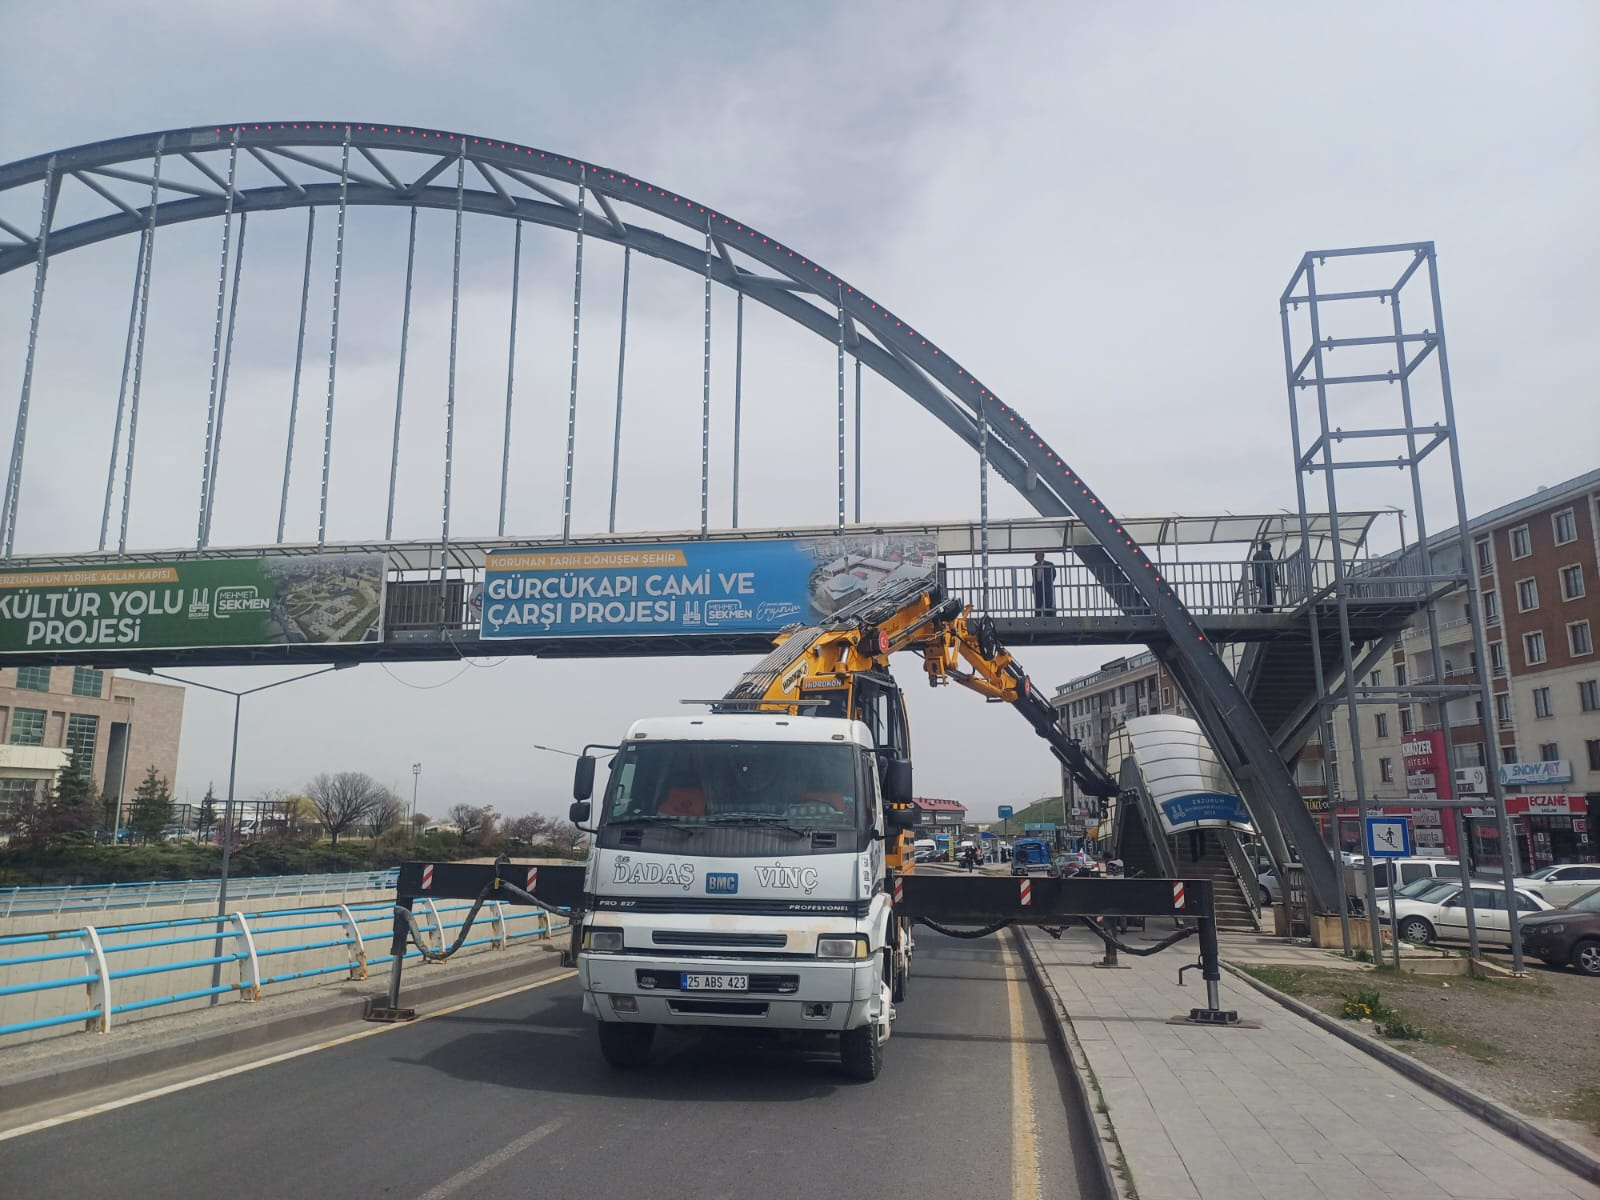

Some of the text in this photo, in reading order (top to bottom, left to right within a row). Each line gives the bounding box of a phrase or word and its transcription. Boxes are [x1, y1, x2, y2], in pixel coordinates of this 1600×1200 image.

[491, 557, 546, 568] KORUNAN
[549, 554, 581, 566] TARİH
[642, 551, 676, 565] ŞEHİR
[64, 572, 98, 583] TARİHE
[488, 568, 755, 600] GÜRCÜKAPI CAMİ VE
[219, 591, 254, 600] MEHMET
[0, 587, 184, 619] KÜLTÜR YOLU
[219, 598, 270, 610] SEKMEN
[487, 595, 677, 632] ÇARŞI PROJESİ
[709, 610, 753, 620] SEKMEN
[27, 618, 141, 645] PROJESİ
[1512, 764, 1542, 777] SNOW
[1529, 795, 1567, 807] ECZANE
[613, 862, 694, 891] DADAŞ
[709, 876, 735, 890] BMC
[755, 861, 819, 895] VİNÇ
[688, 976, 746, 989] 25 ABS 423
